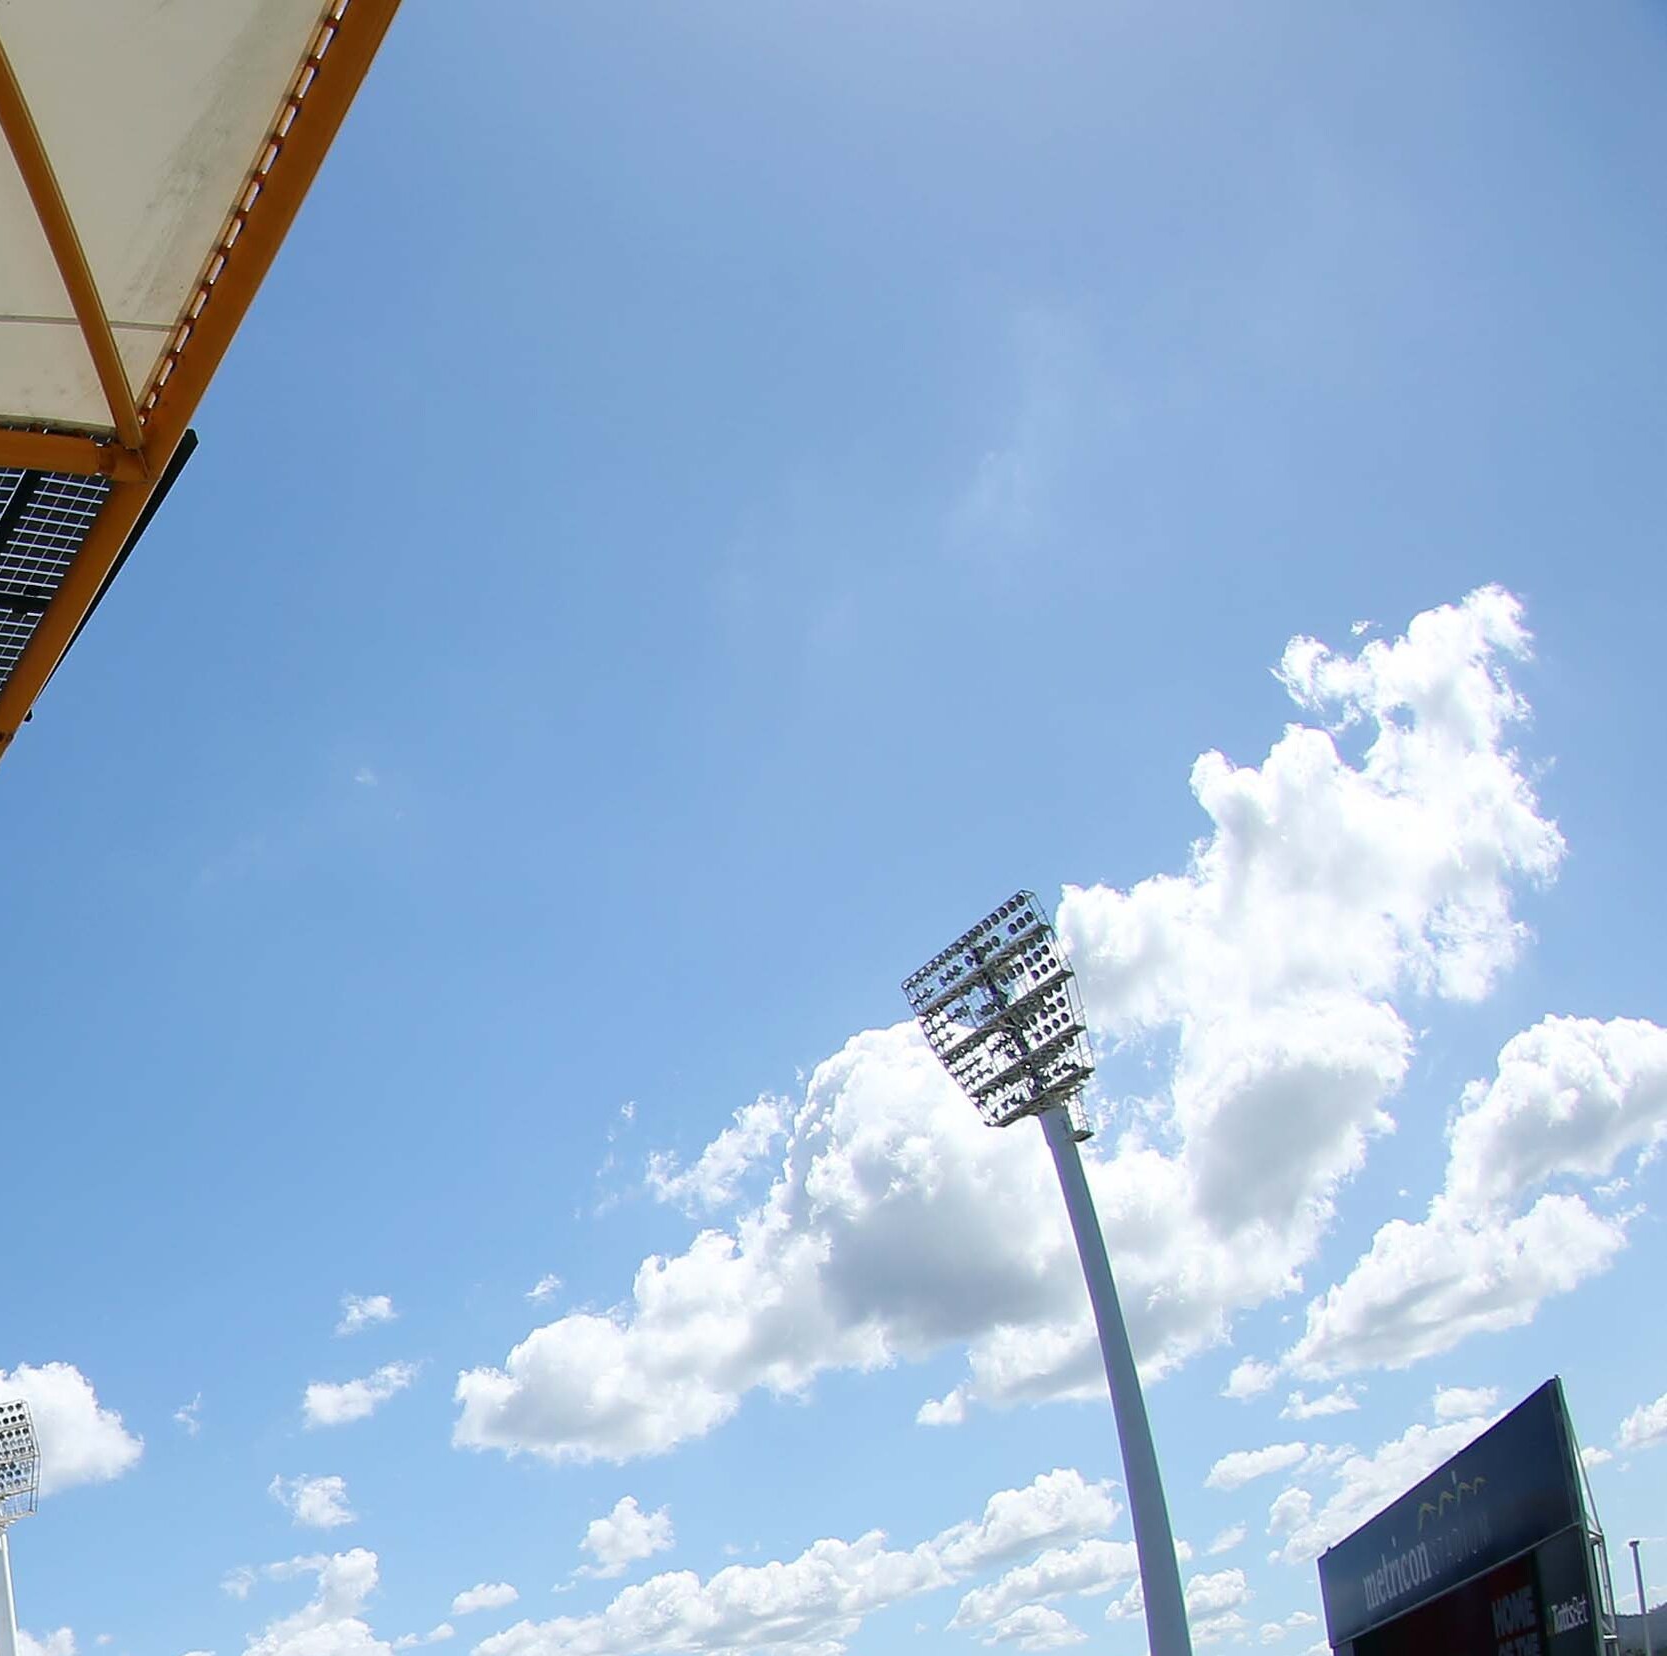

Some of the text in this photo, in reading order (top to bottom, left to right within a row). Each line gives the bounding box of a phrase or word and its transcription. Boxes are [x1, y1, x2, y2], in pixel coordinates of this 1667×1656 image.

[1362, 1536, 1432, 1611] metricon
[1491, 1585, 1537, 1640] HOME
[1551, 1594, 1589, 1634] TattsBet
